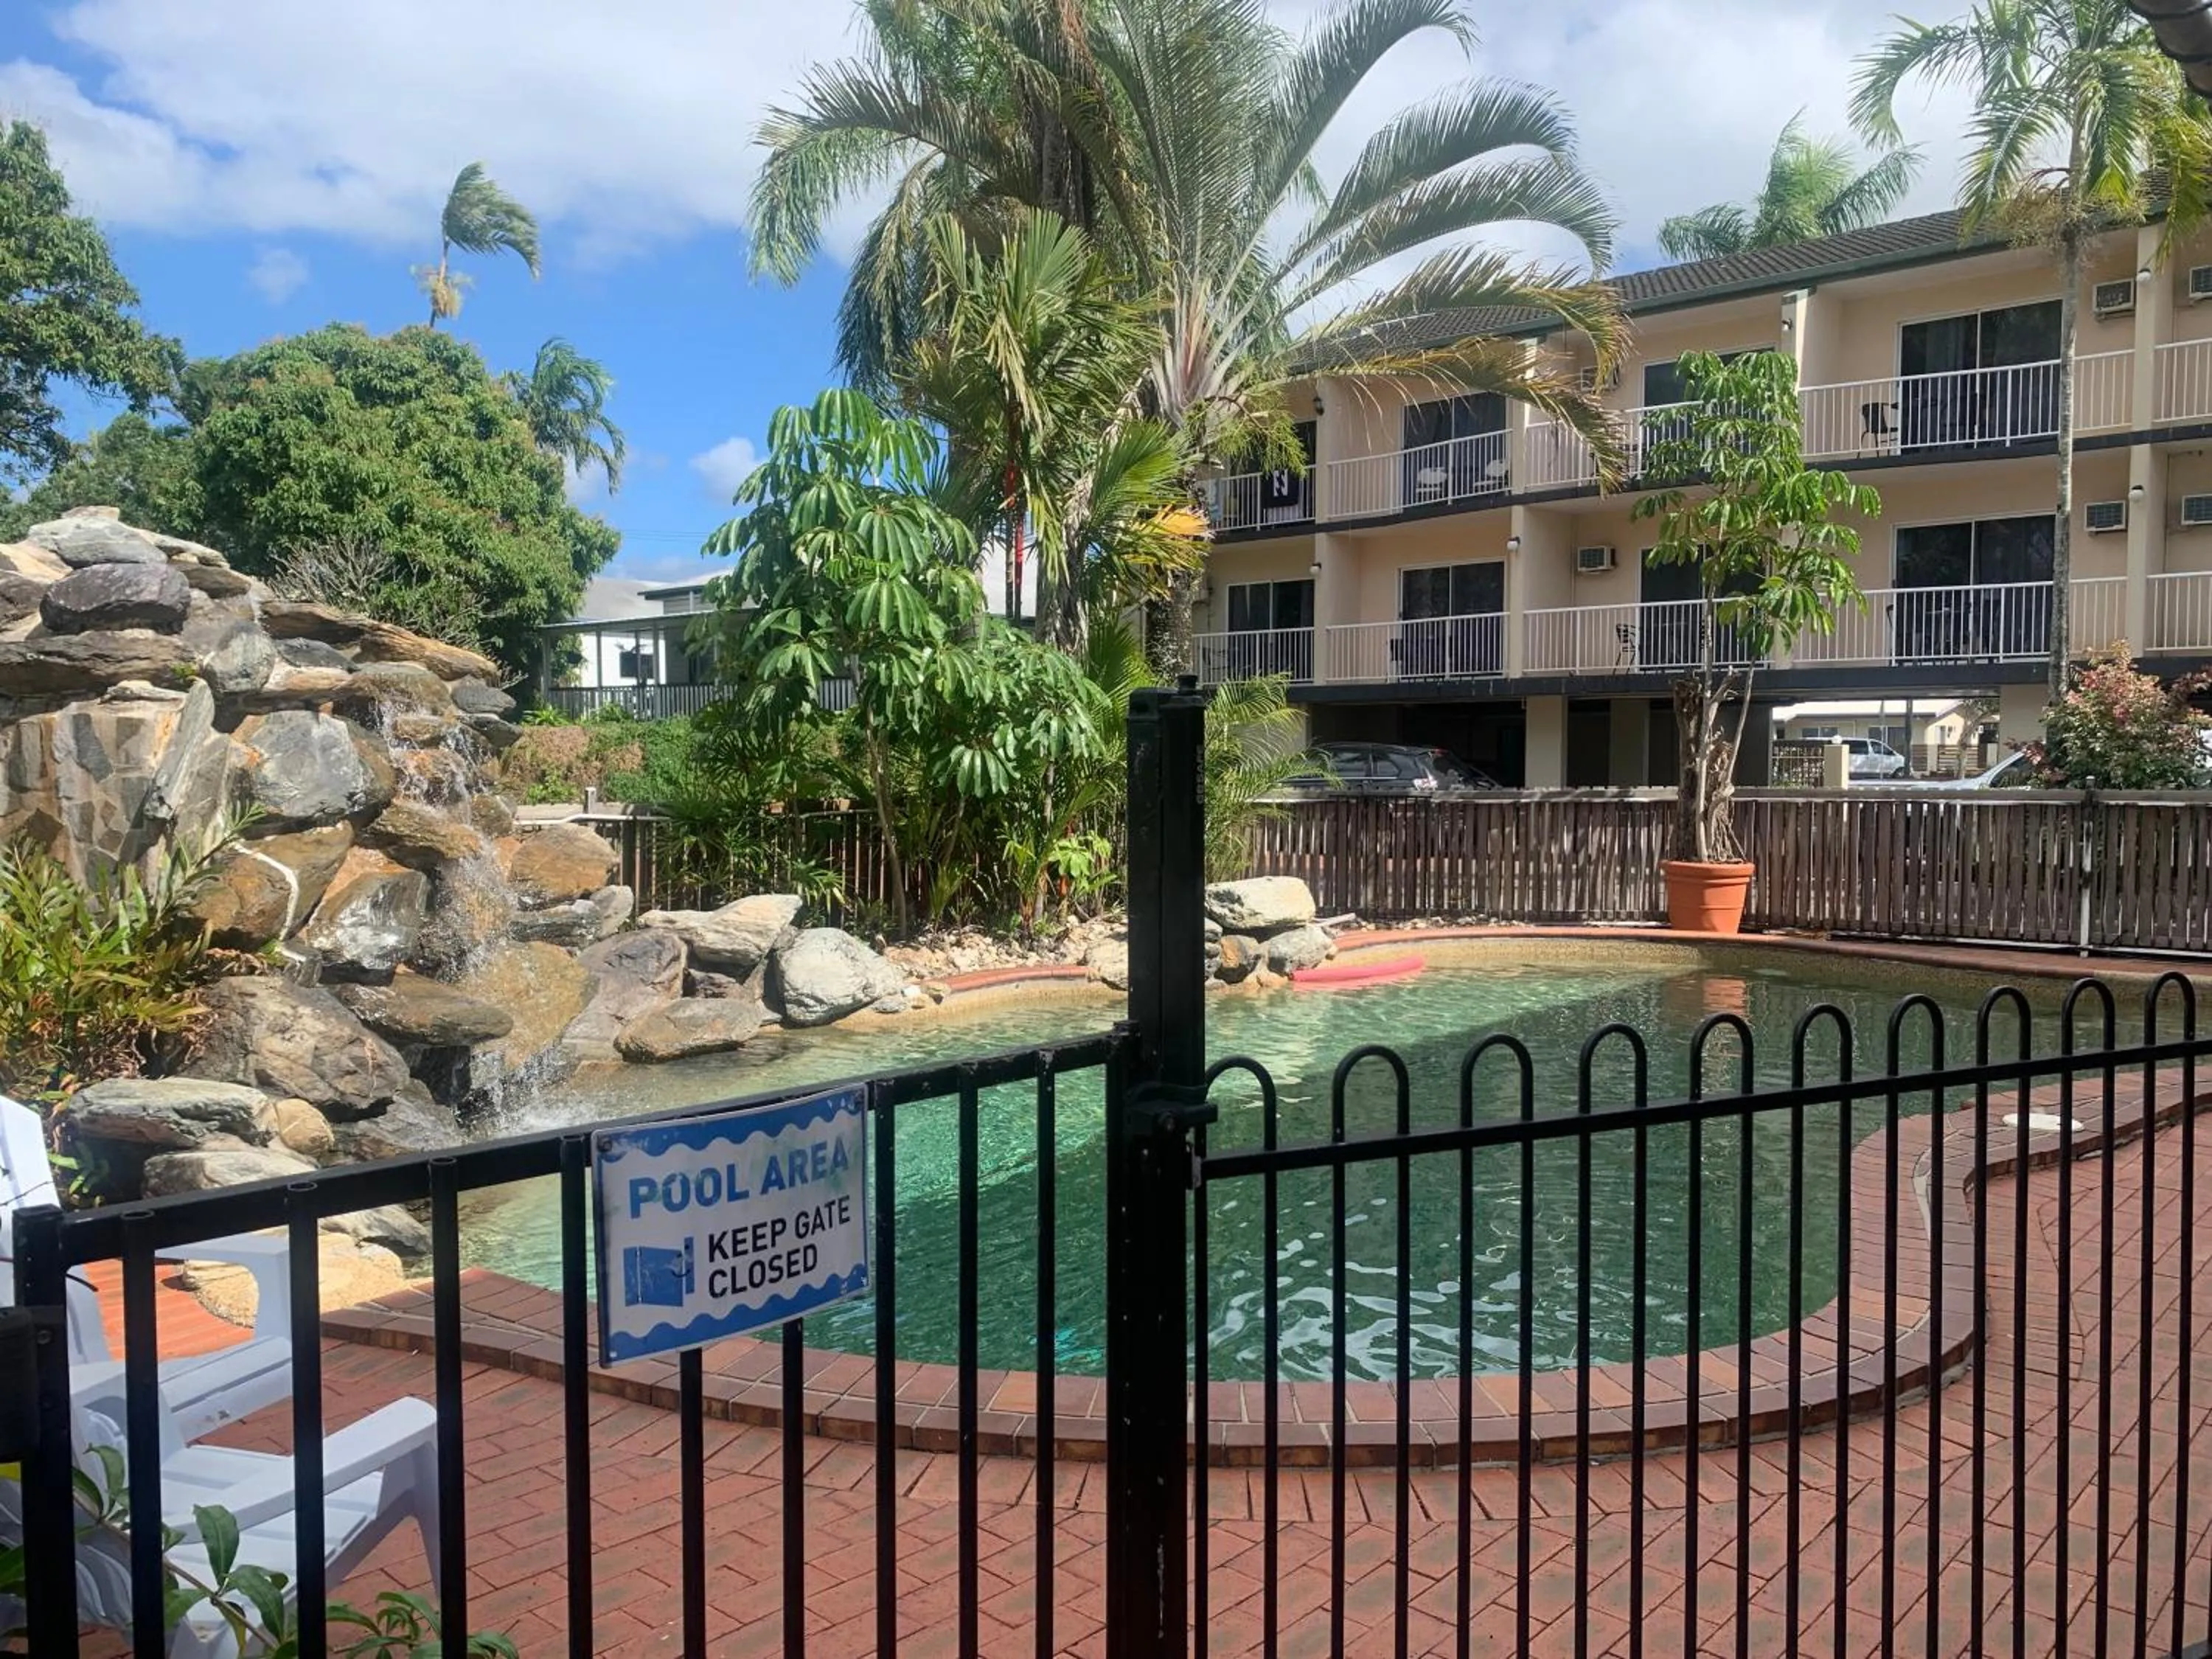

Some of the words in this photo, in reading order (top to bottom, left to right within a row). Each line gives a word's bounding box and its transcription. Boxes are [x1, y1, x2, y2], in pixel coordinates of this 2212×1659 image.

[629, 1164, 750, 1219] POOL
[759, 1135, 849, 1195] AREA
[709, 1217, 787, 1263] KEEP
[795, 1194, 850, 1239] GATE
[709, 1243, 818, 1298] CLOSED
